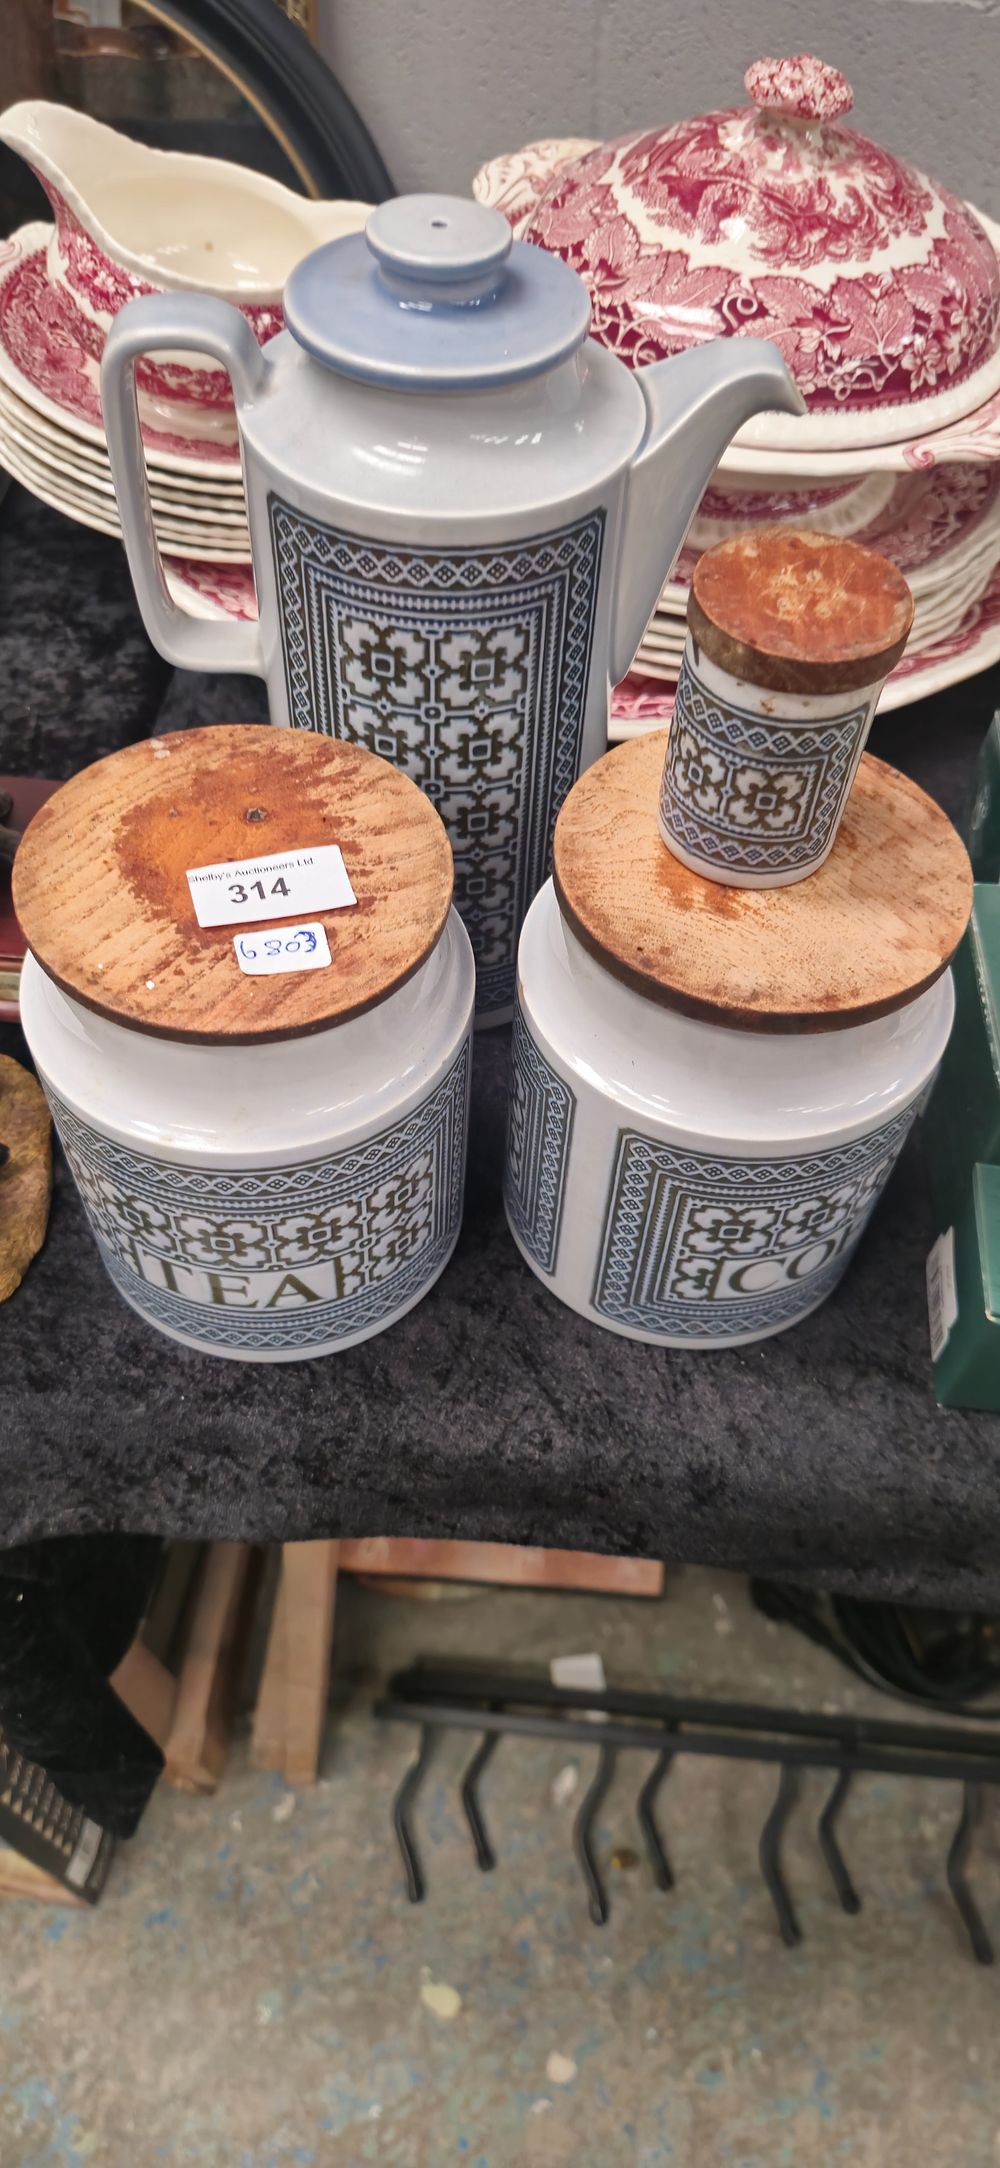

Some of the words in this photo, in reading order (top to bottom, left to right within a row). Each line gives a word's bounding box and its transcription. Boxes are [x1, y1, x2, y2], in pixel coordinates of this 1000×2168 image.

[234, 861, 295, 877] Auctioneers
[297, 857, 314, 867] Ltd
[228, 877, 291, 904] 314
[143, 1249, 325, 1308] TEA
